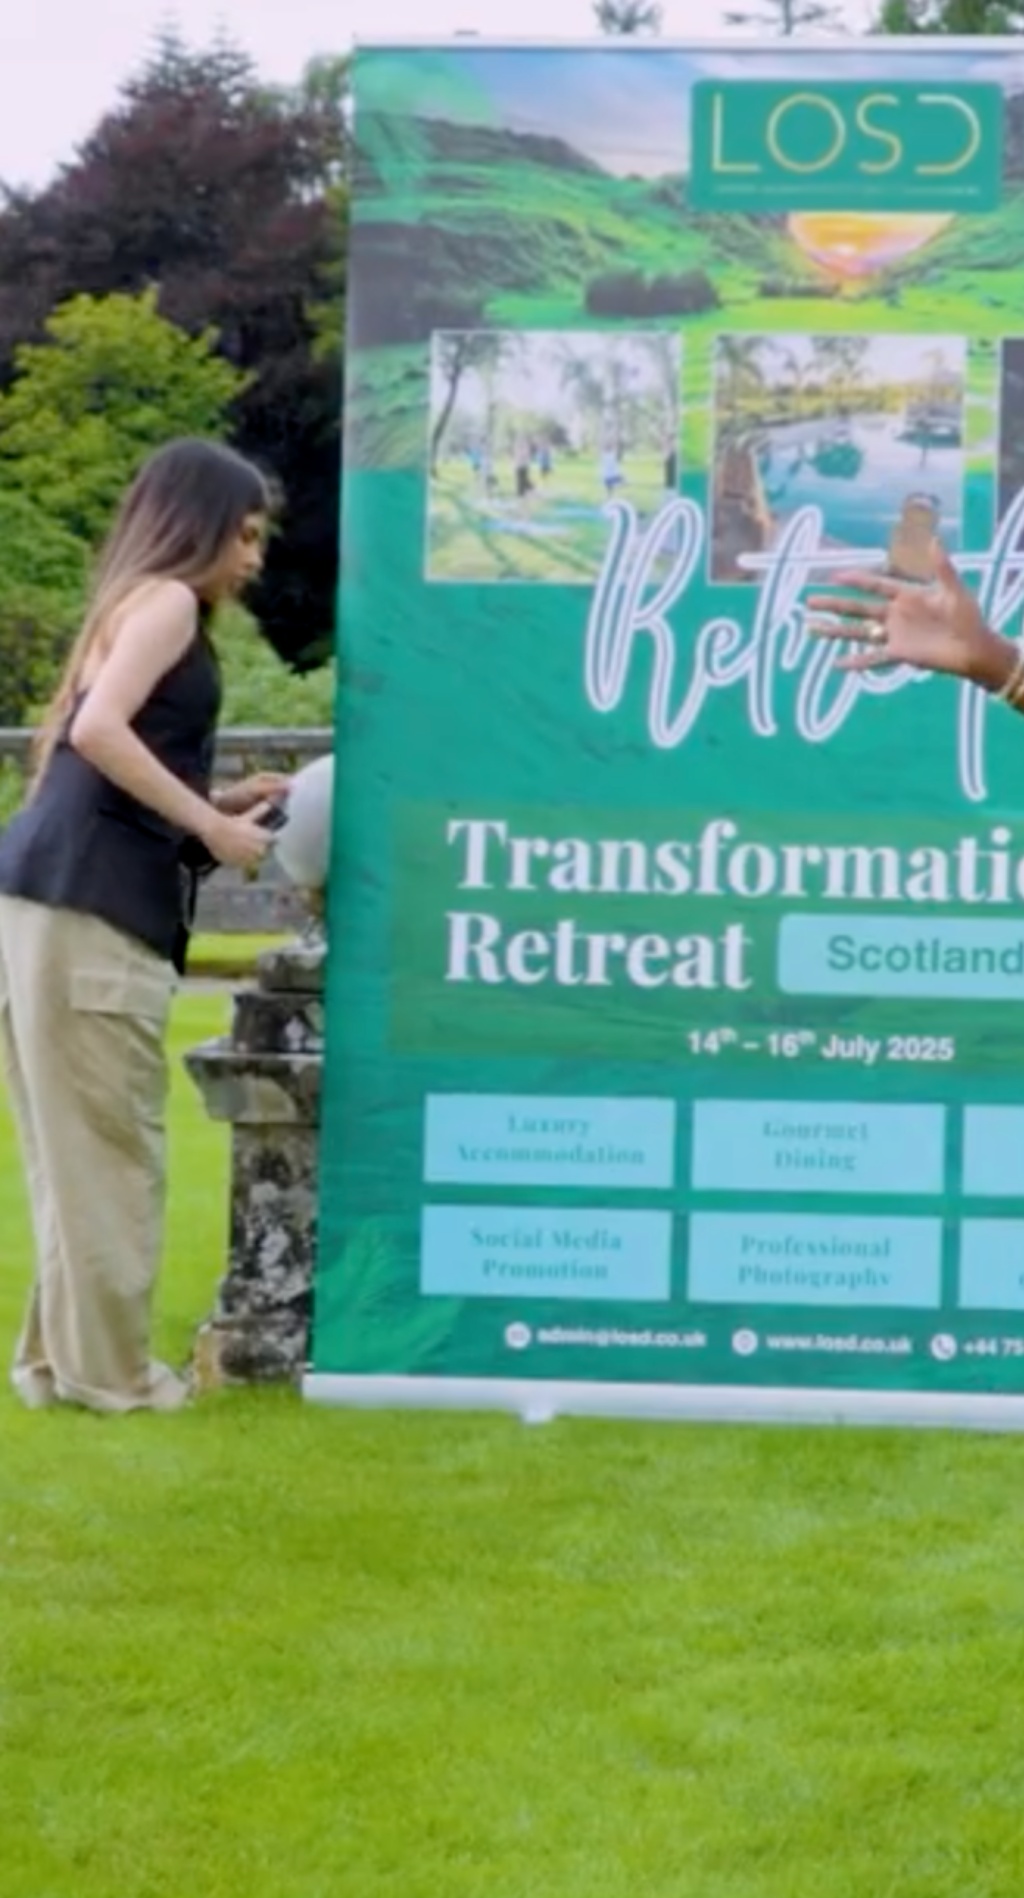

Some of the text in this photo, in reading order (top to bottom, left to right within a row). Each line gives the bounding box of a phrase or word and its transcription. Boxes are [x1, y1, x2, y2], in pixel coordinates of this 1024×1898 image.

[712, 91, 981, 174] LOSD
[444, 911, 753, 991] Retreat
[821, 1033, 881, 1066] July
[886, 1036, 955, 1062] 2025
[457, 1144, 645, 1166] Accommodation
[774, 1149, 858, 1172] Dining
[470, 1228, 622, 1251] Social Media
[741, 1235, 891, 1258] Professional
[482, 1259, 608, 1280] Promotion
[738, 1265, 892, 1291] Photography
